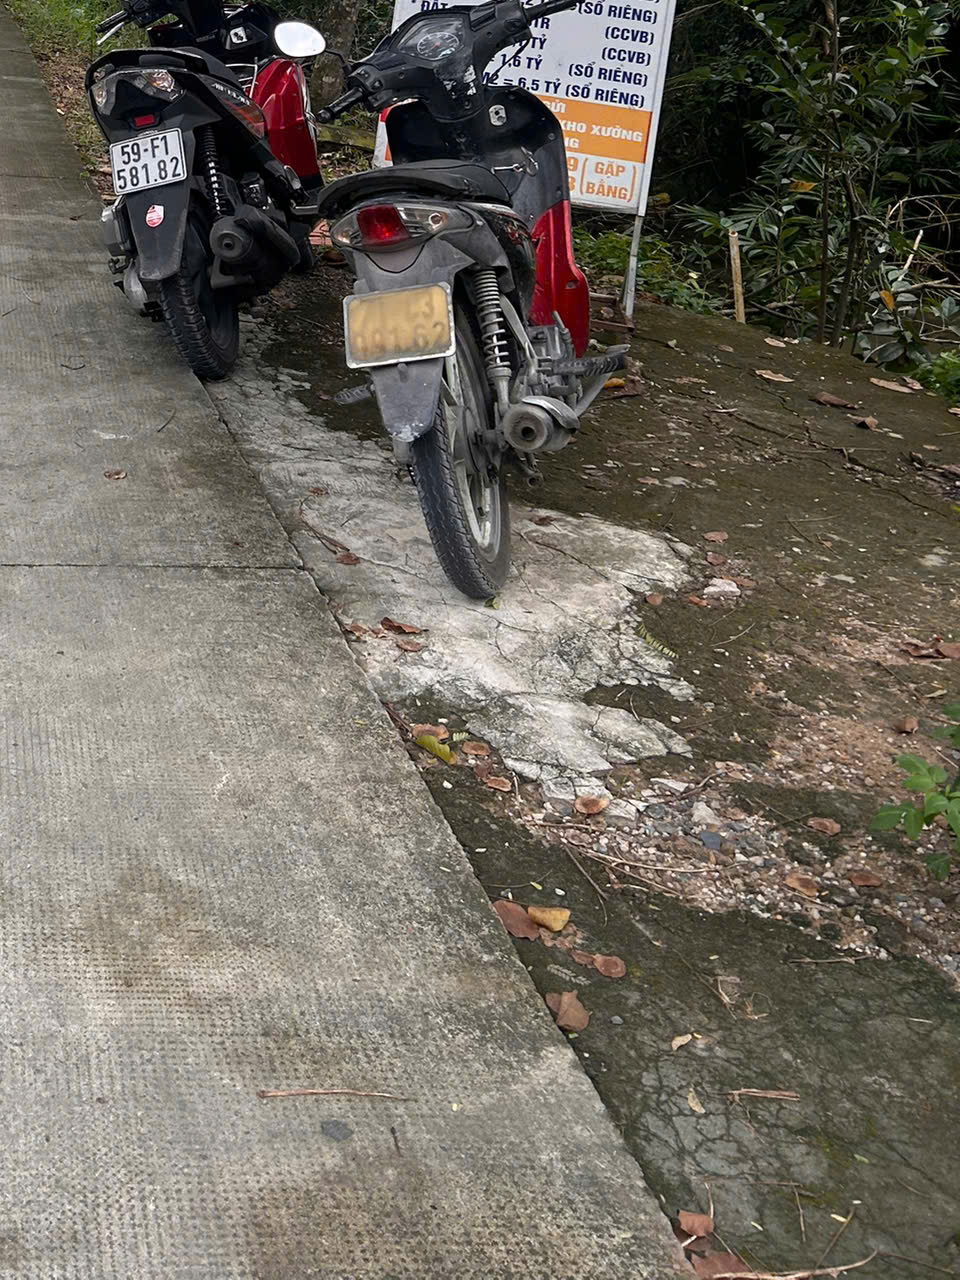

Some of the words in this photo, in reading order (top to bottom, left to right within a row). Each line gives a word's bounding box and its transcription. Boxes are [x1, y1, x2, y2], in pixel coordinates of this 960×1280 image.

[607, 4, 658, 25] RIÊNG)
[605, 26, 654, 46] (CCVB)
[526, 54, 543, 70] TỶ
[598, 65, 648, 87] RIÊNG)
[602, 47, 651, 67] (CCVB)
[544, 78, 561, 95] TỶ
[595, 87, 645, 108] RIÊNG)
[120, 135, 169, 165] 59-F1
[117, 156, 181, 190] 581.82
